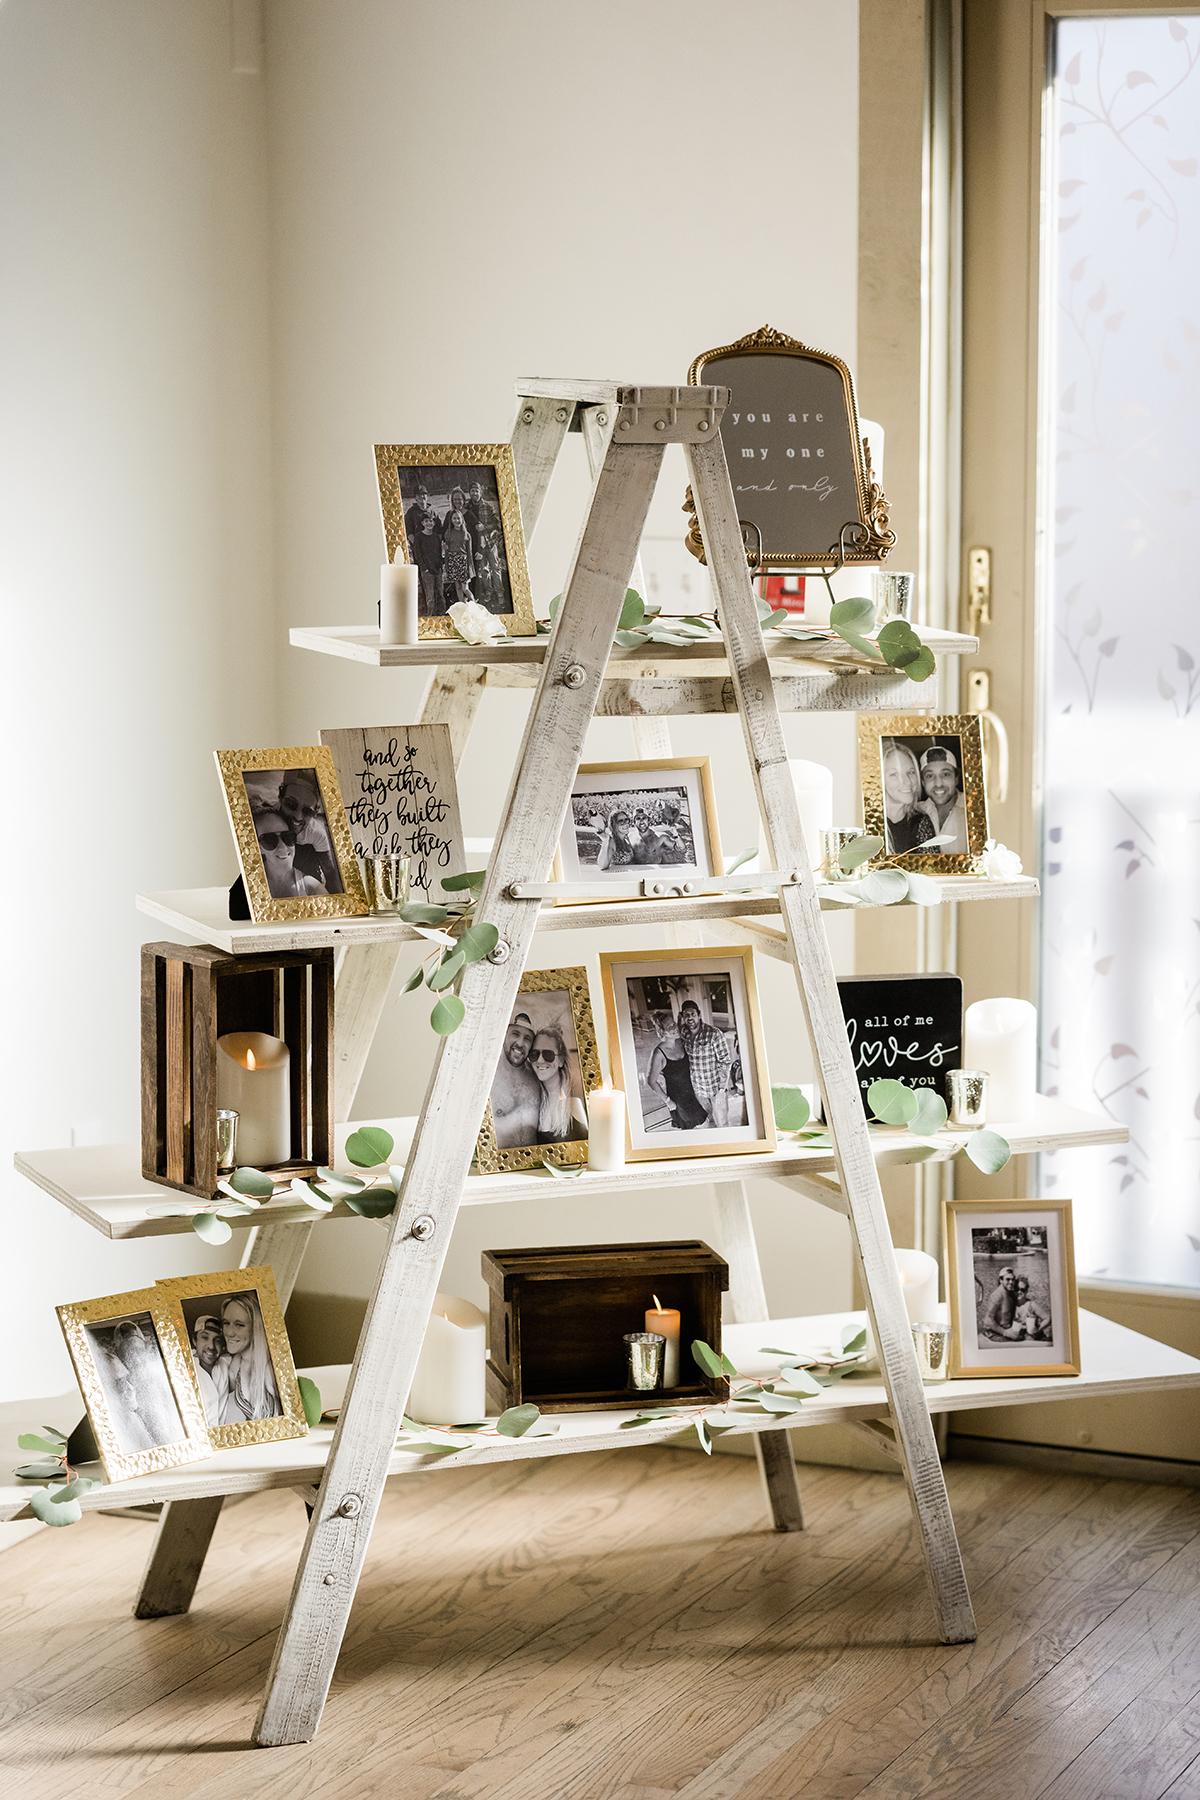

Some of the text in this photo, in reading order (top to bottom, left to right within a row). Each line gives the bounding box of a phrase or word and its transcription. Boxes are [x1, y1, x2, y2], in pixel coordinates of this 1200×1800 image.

[732, 412, 824, 425] you are
[741, 447, 825, 461] my one
[736, 476, 838, 501] and only
[363, 738, 418, 767] and so
[355, 765, 437, 805] together
[344, 796, 451, 835] they built
[354, 842, 369, 859] a
[405, 826, 452, 866] they
[864, 1015, 934, 1027] all of me
[909, 1076, 936, 1088] you
